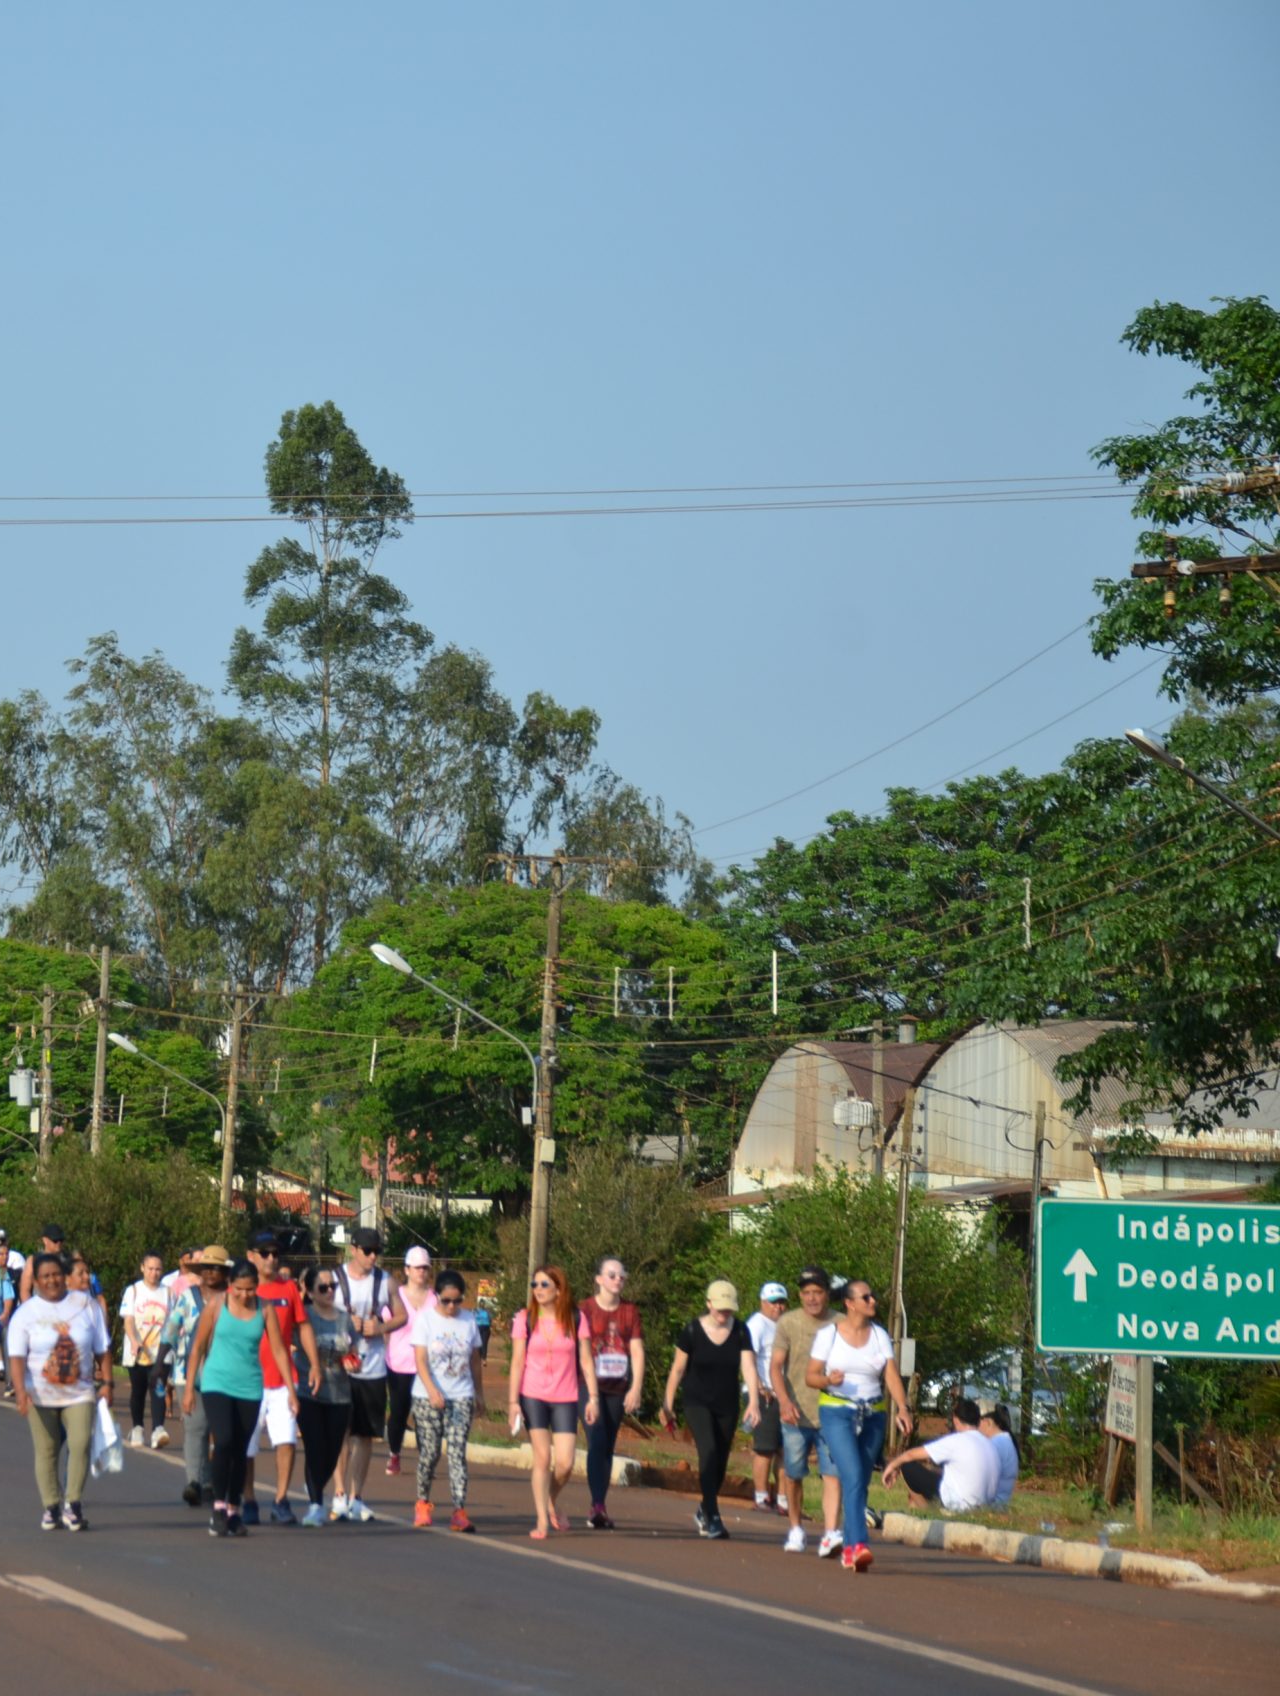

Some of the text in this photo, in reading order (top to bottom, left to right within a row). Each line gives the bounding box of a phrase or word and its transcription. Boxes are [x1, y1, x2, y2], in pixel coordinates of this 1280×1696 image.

[1117, 1213, 1280, 1247] Indápolis
[1117, 1262, 1275, 1298] Deodápol
[1116, 1313, 1280, 1344] Nova And
